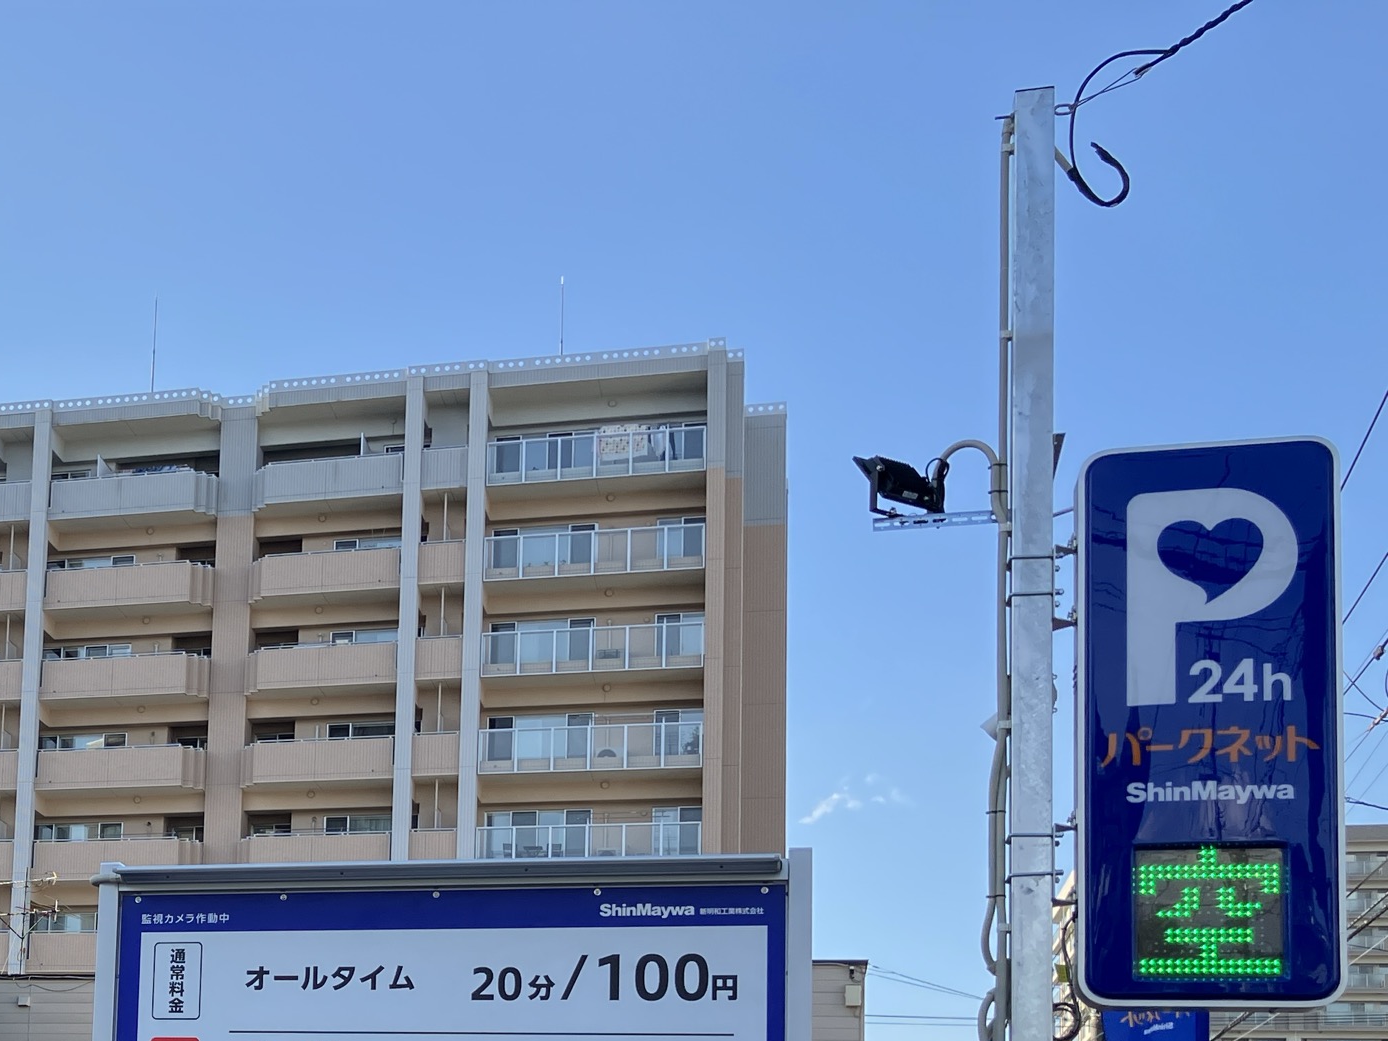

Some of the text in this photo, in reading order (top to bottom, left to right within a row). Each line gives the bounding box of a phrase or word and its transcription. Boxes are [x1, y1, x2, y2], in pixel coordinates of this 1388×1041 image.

[1188, 658, 1292, 703] 24h
[1100, 725, 1321, 768] パークネット
[1125, 780, 1295, 804] ShinMaywa
[140, 912, 230, 926] 監視カメラ作動中
[599, 903, 695, 918] ShinMaywa
[1138, 845, 1281, 975] 空
[167, 948, 187, 1014] 通常料金
[245, 965, 415, 991] オールタイム
